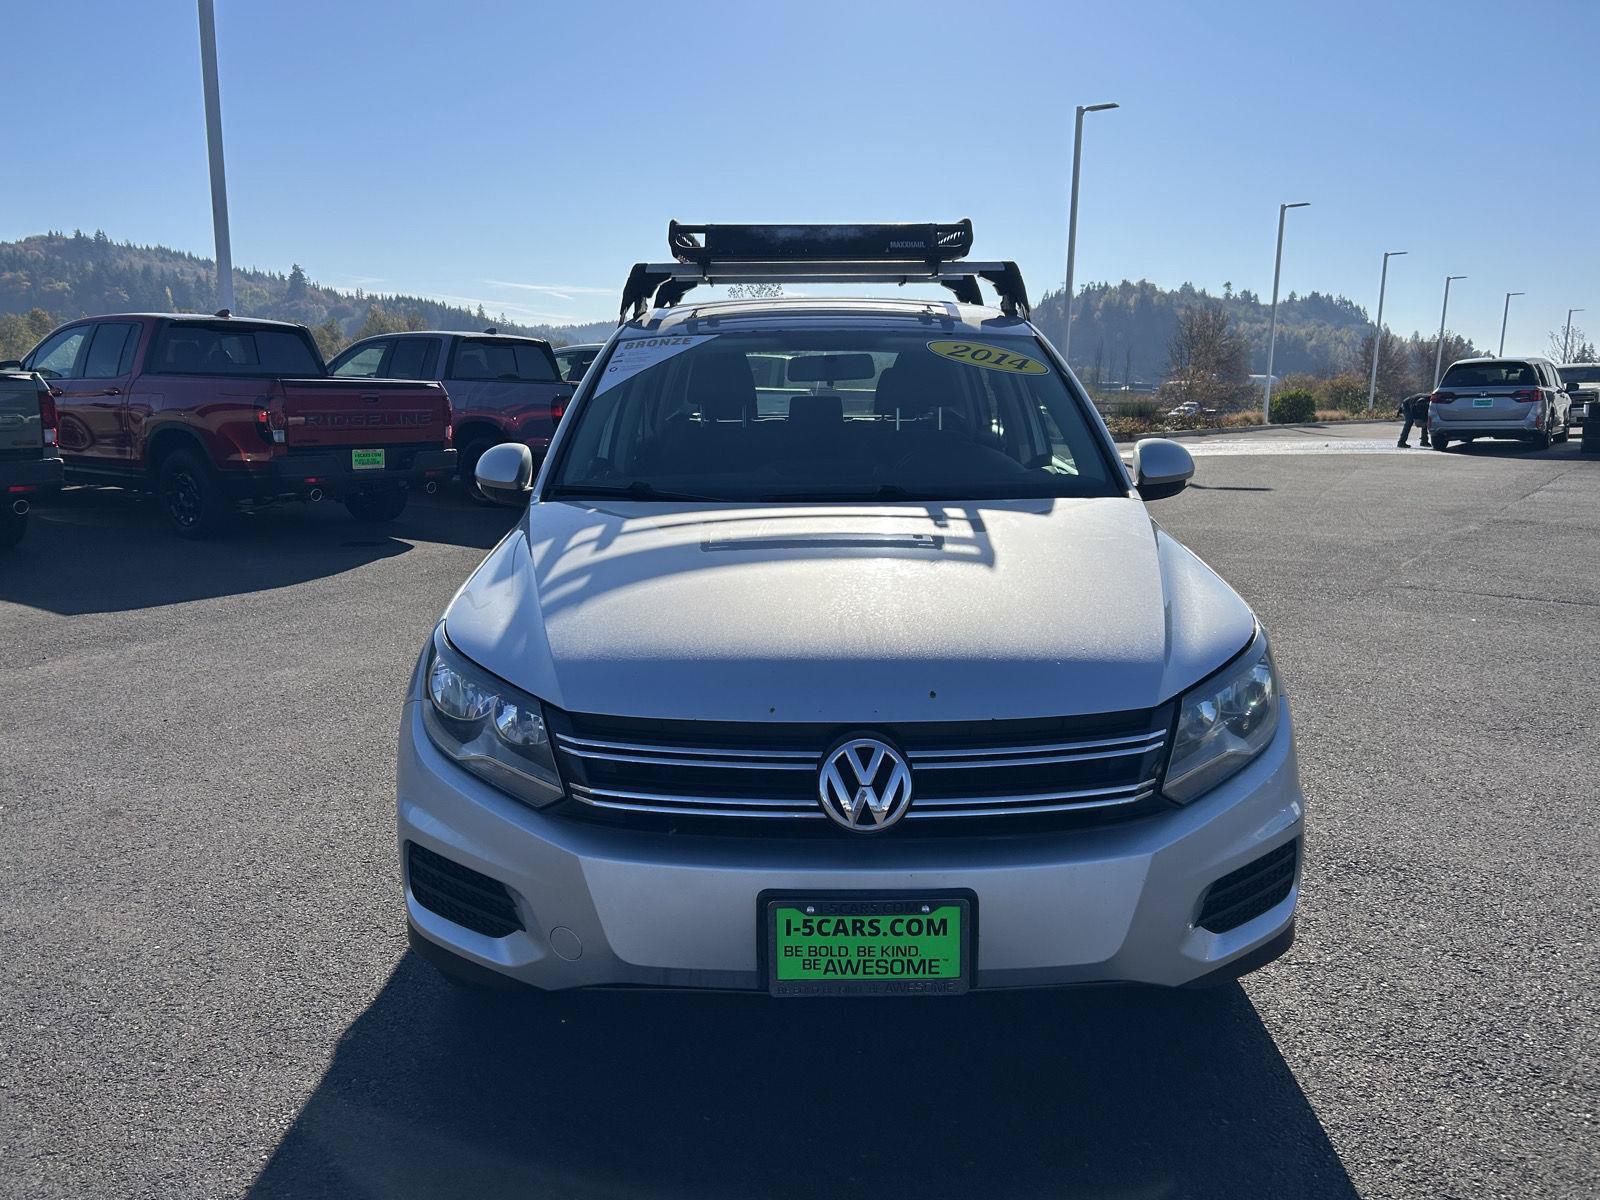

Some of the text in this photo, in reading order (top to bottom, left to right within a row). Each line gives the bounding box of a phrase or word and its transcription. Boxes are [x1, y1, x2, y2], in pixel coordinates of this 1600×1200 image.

[624, 337, 694, 350] BRONZE
[948, 344, 1031, 370] 2014
[304, 412, 433, 427] RIDGELINE
[785, 918, 948, 937] I-5CARS.COM
[784, 945, 922, 957] BE BOLD. BE KIND.
[802, 958, 821, 970] BE
